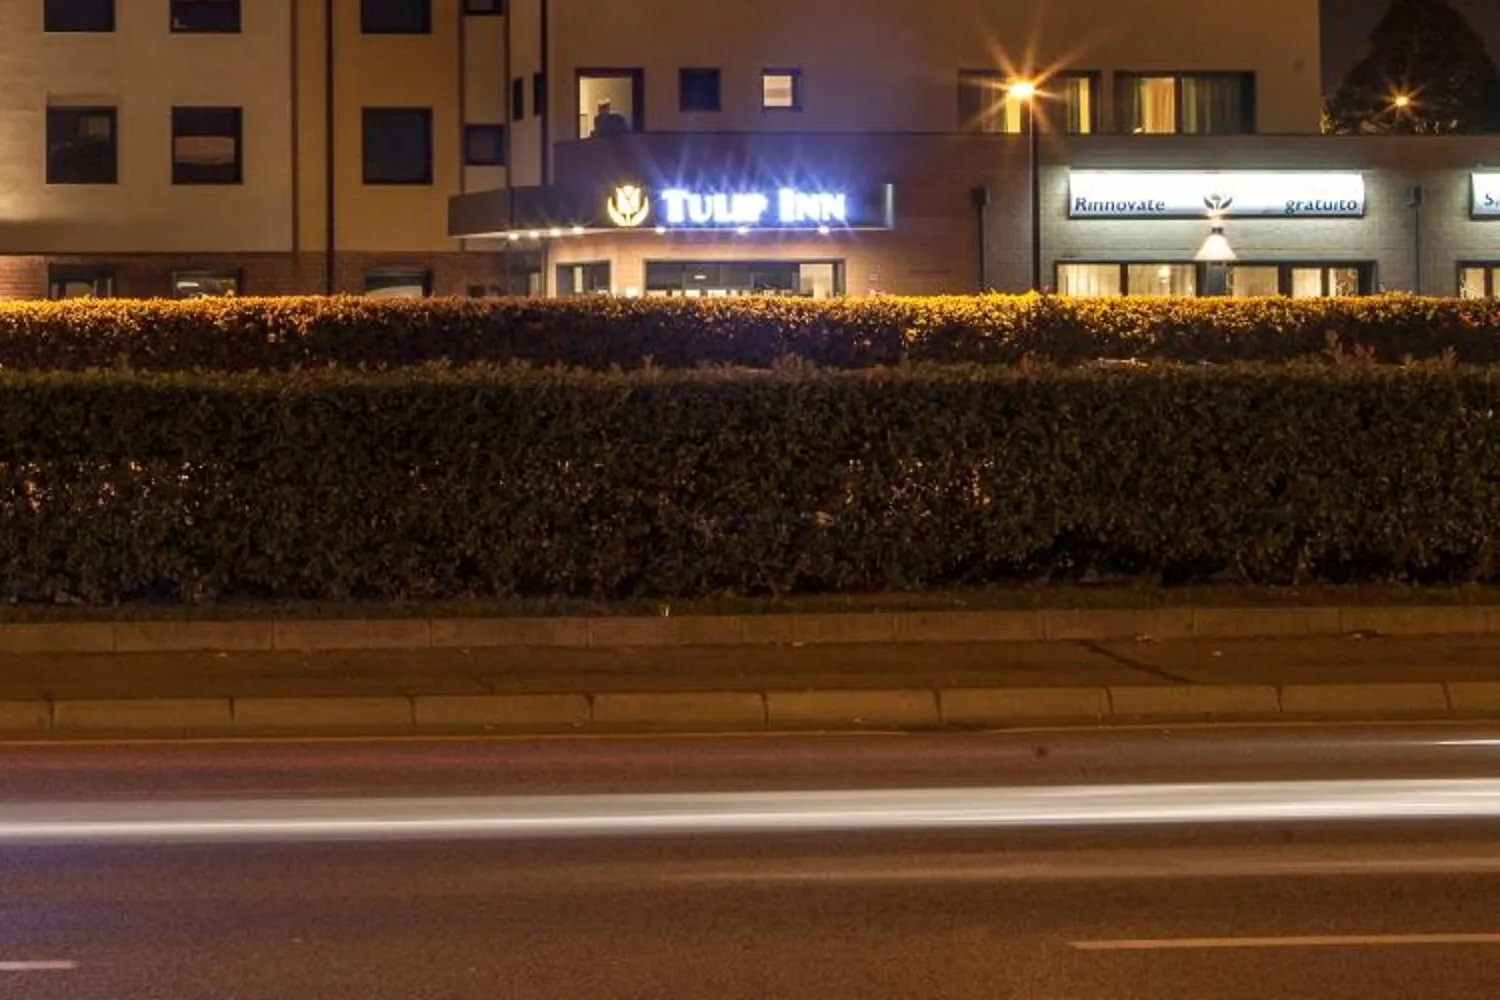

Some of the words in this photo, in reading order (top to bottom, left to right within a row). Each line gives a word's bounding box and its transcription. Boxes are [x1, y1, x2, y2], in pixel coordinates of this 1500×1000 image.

[661, 189, 768, 223] TULIP
[779, 187, 846, 222] INN
[1074, 196, 1166, 213] Rinnovate
[1284, 198, 1358, 214] gratuito
